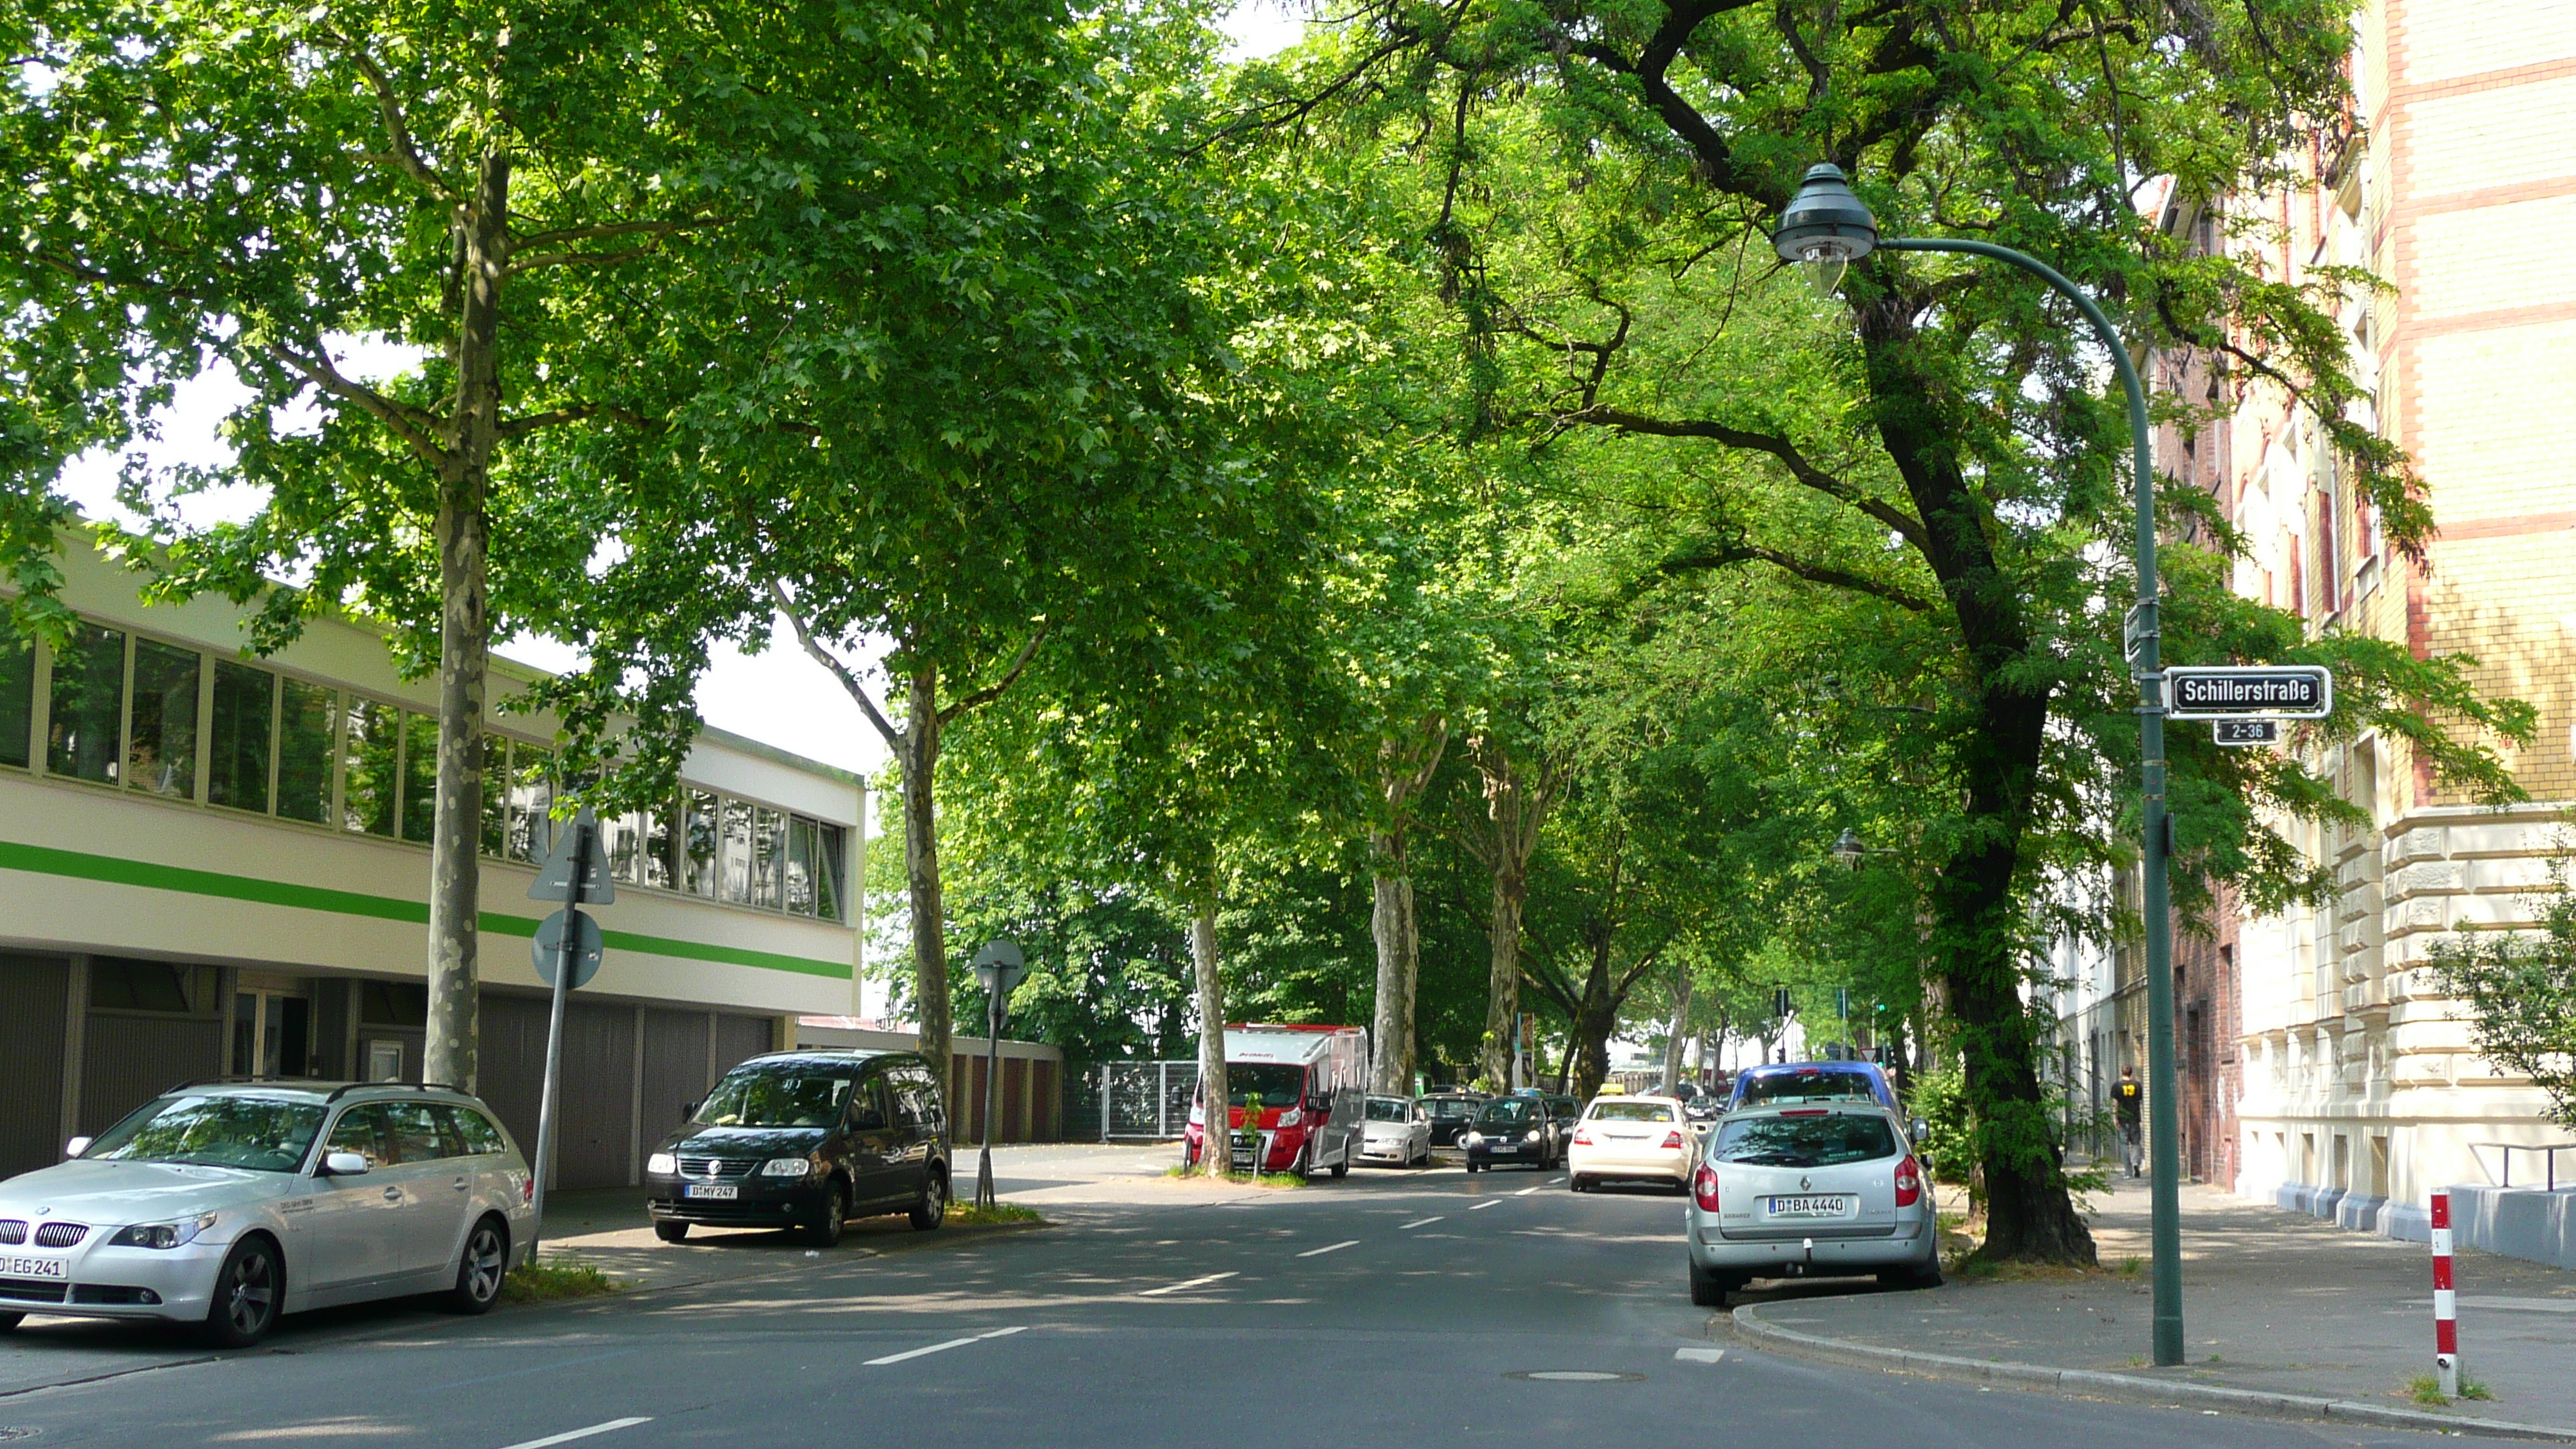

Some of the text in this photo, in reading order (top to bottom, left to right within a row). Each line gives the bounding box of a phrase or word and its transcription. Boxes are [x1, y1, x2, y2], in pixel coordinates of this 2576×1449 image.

[2184, 679, 2310, 701] Schillerstraße
[2232, 724, 2264, 738] 2-36
[692, 1187, 699, 1197] D
[716, 1187, 735, 1197] 247
[1777, 1198, 1843, 1212] D BA 4440
[14, 1259, 32, 1274] EG
[34, 1260, 60, 1276] 241
